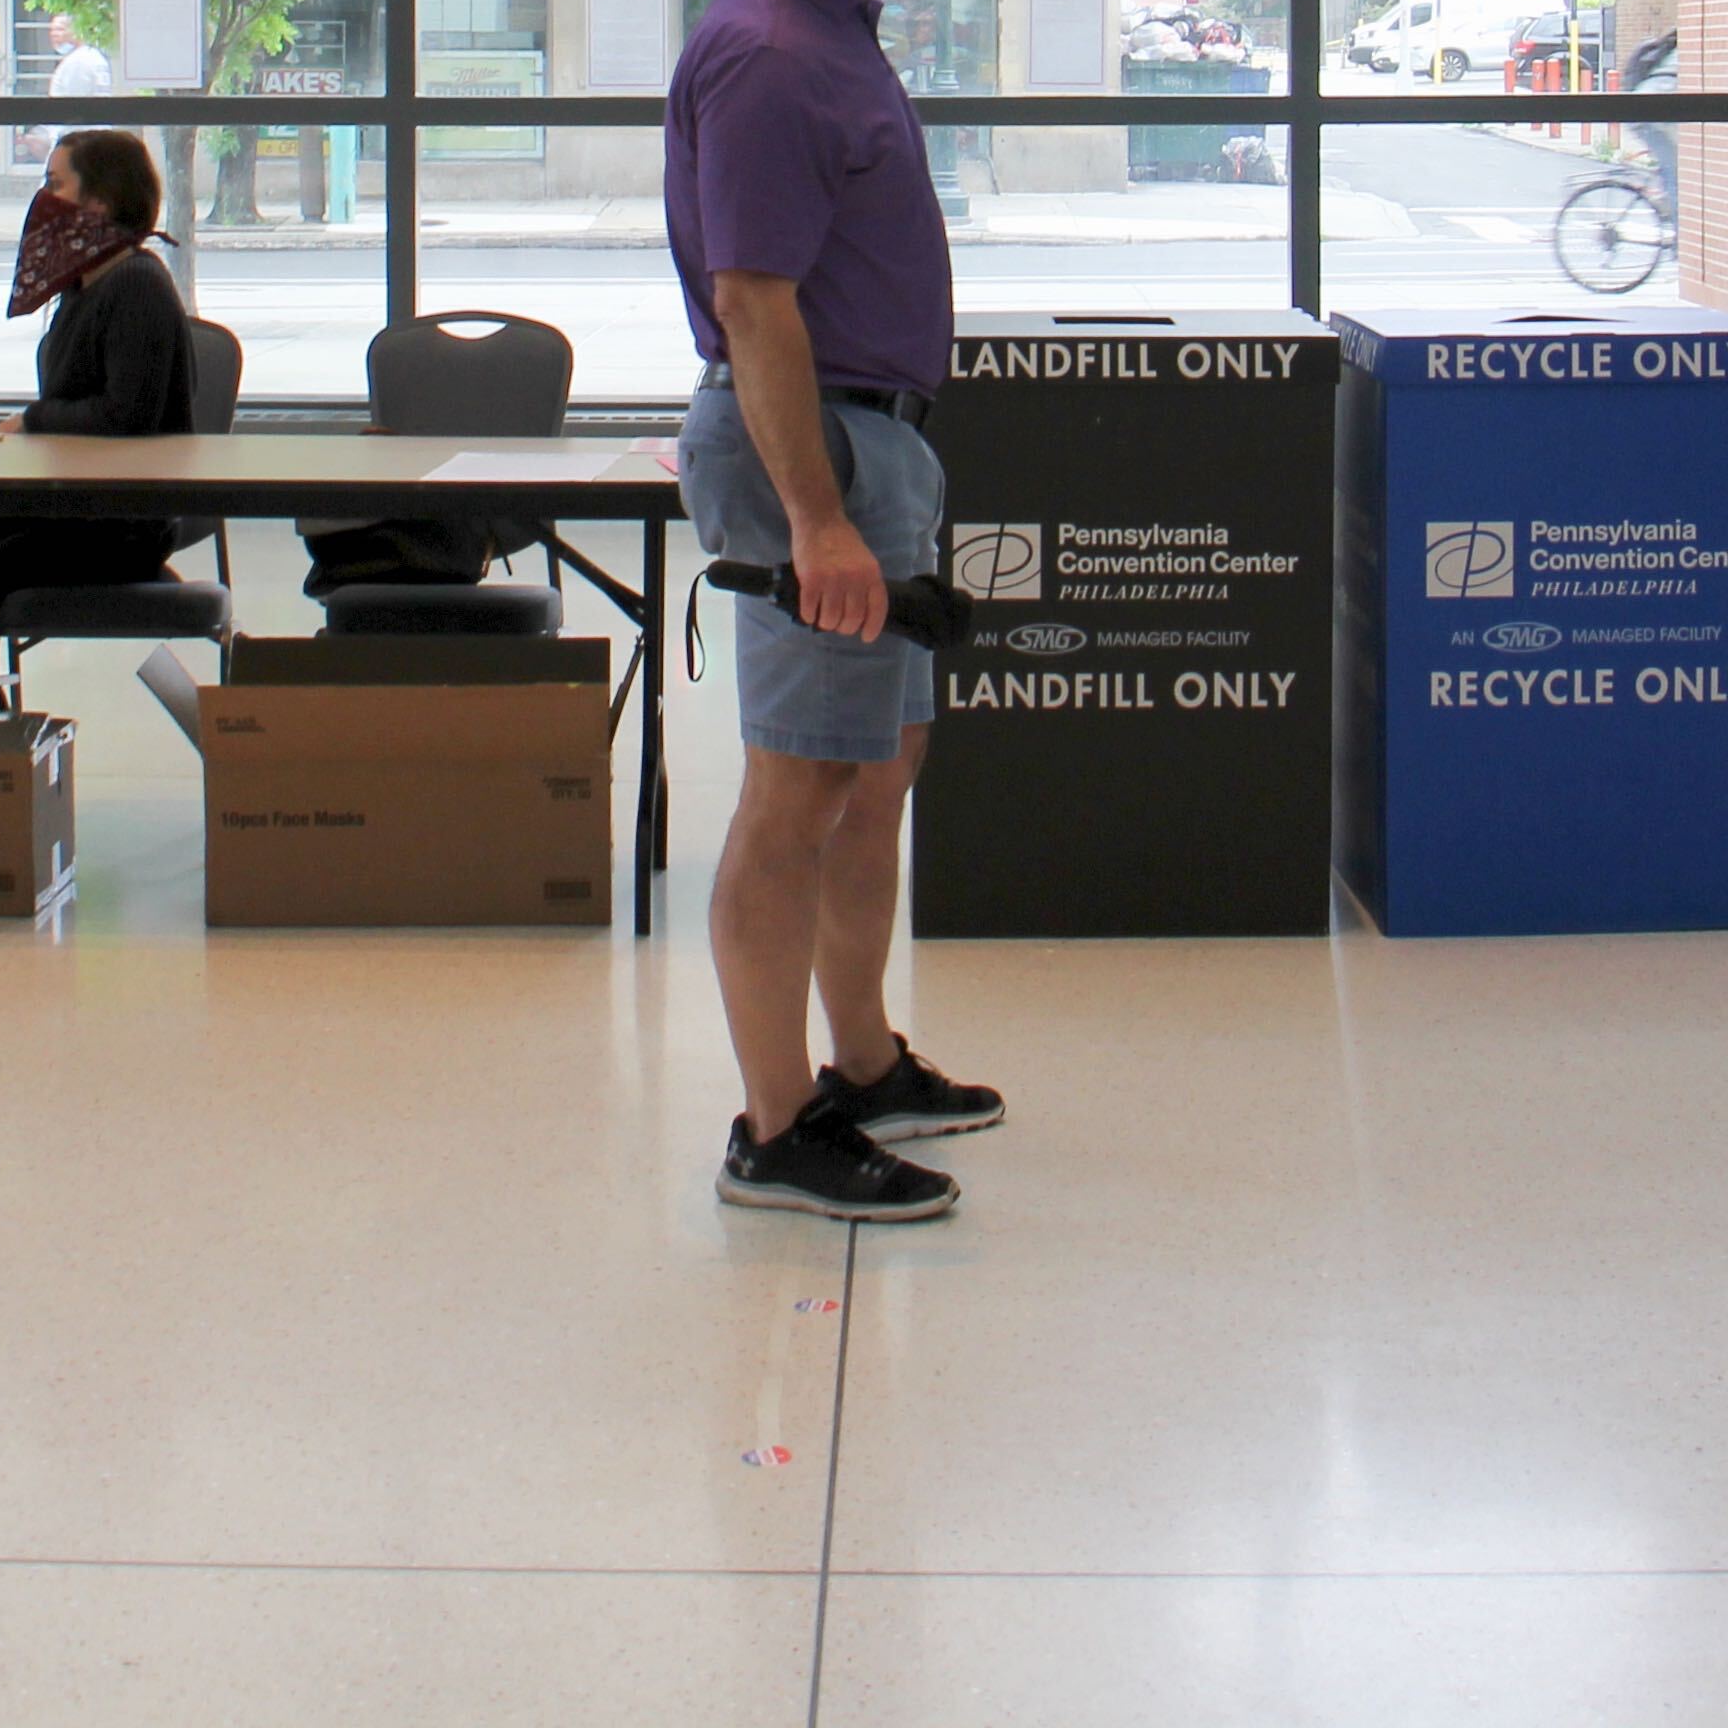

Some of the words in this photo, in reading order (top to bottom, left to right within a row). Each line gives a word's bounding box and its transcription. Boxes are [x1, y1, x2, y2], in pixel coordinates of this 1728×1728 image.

[950, 342, 1158, 379] LANDFILL
[1177, 342, 1300, 379] ONLY
[1427, 342, 1613, 379] RECYCLE
[1058, 523, 1229, 550] Pennsylvania
[1530, 519, 1697, 546] Pennsylvania
[1057, 551, 1206, 574] Convention
[1210, 551, 1299, 574] Center
[1529, 548, 1675, 571] Convention
[1059, 583, 1230, 601] PHILADELPHIA
[1531, 579, 1698, 598] PHILADELPHIA
[974, 632, 998, 647] AN
[1021, 627, 1072, 650] SMG
[1097, 631, 1182, 647] MANAGED
[1187, 631, 1251, 647] FACILITY
[1451, 631, 1474, 647] AN
[1495, 627, 1547, 649] SMG
[1573, 628, 1655, 644] MANAGED
[1660, 626, 1723, 642] FACILITY
[948, 672, 1155, 709] LANDFILL
[1173, 671, 1297, 709] ONLY
[1430, 669, 1615, 708] RECYCLE
[222, 811, 268, 830] 10pcs
[273, 811, 310, 827] Face
[314, 811, 366, 827] Masks
